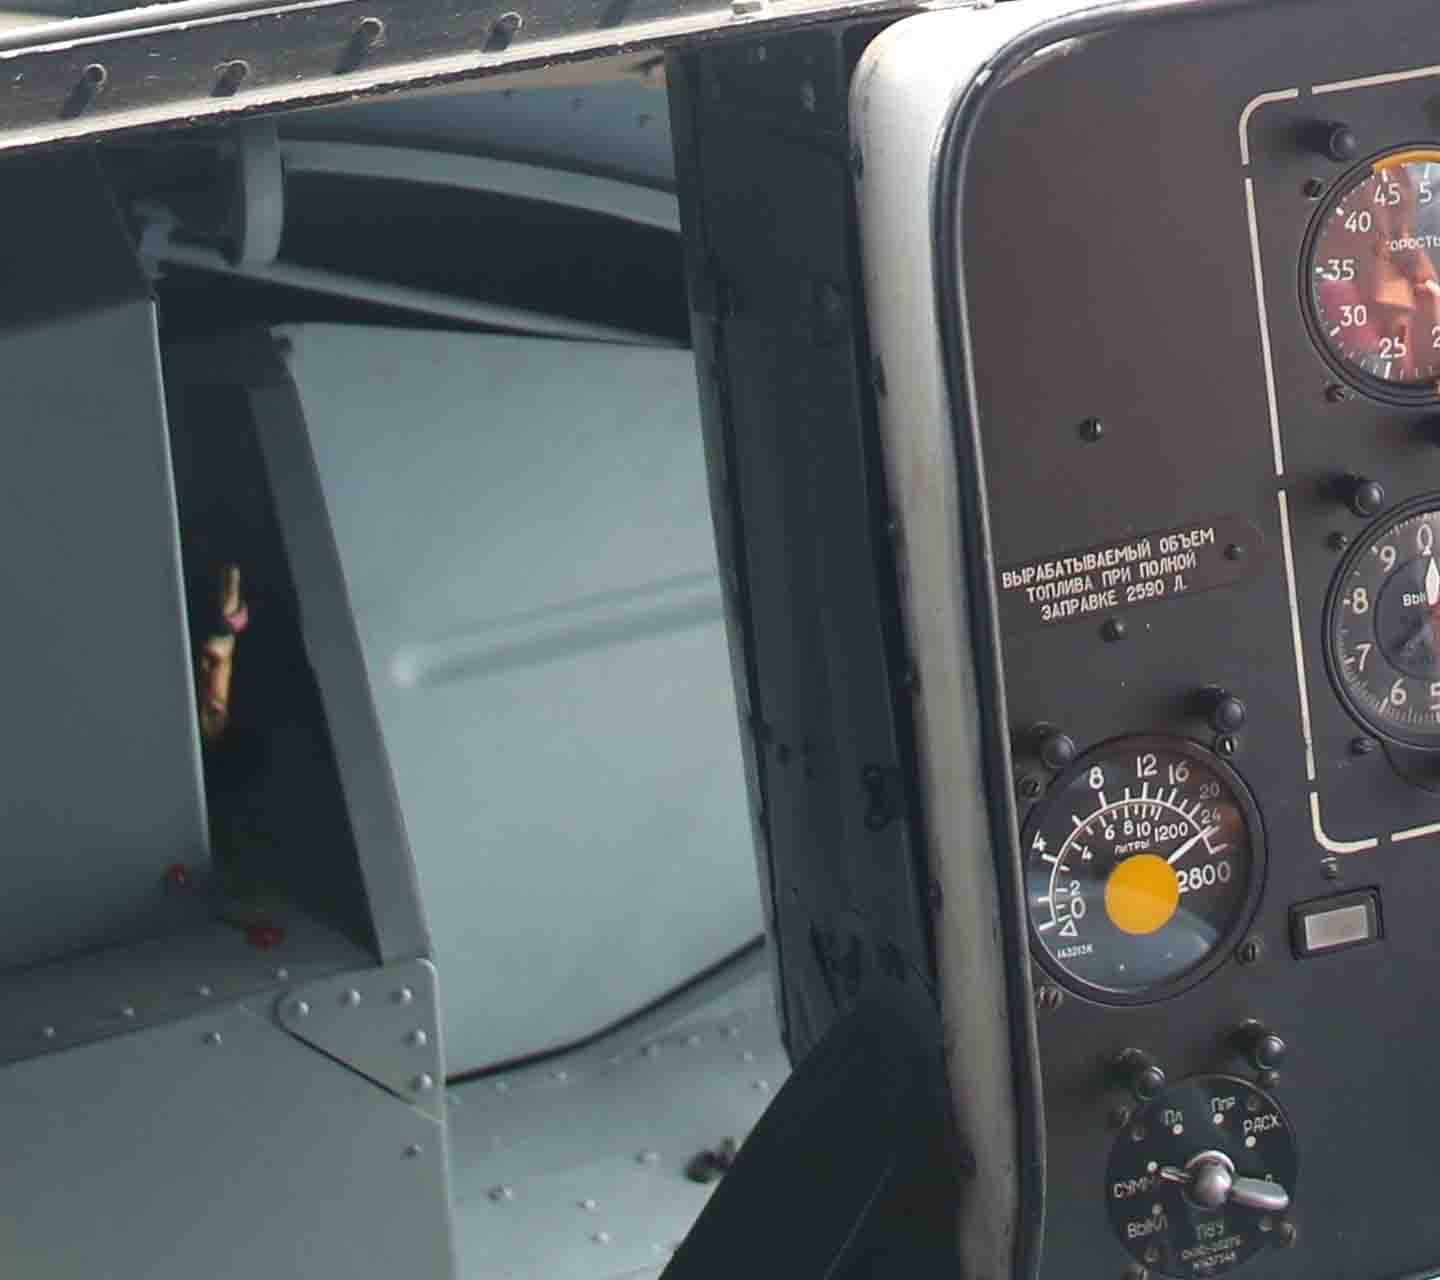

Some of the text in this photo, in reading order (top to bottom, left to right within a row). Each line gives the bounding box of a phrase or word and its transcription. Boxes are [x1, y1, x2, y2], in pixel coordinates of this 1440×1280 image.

[1373, 183, 1401, 206] 45
[1419, 181, 1433, 203] 5
[1344, 211, 1372, 233] 40
[1328, 259, 1355, 281] 35
[1339, 304, 1368, 328] 30
[1379, 337, 1408, 360] 25
[1002, 527, 1216, 589] ВЫРАБАТЫВАЕМЫЙ ОБЪЕМ
[1380, 545, 1397, 572] 9
[1026, 549, 1197, 604] ТОПЛИВА ПРИ ПОЛНОЙ
[1041, 574, 1189, 622] ЗАПРАВКЕ 2590 Л.
[1353, 587, 1369, 615] 8
[1355, 643, 1373, 672] 7
[1390, 677, 1408, 706] 6
[1136, 753, 1158, 778] 12
[1168, 761, 1190, 785] 16
[1089, 766, 1105, 790] 8
[1199, 783, 1221, 800] 20
[1123, 819, 1135, 836] 8
[1201, 807, 1222, 825] 24
[1031, 831, 1046, 852] 4
[1104, 824, 1116, 841] 6
[1136, 821, 1152, 839] 10
[1154, 821, 1189, 843] 1200
[1081, 846, 1094, 861] 4
[1069, 880, 1082, 896] 2
[1175, 861, 1231, 894] 2800
[1071, 896, 1087, 920] 0
[1243, 1114, 1283, 1136] РАСХ
